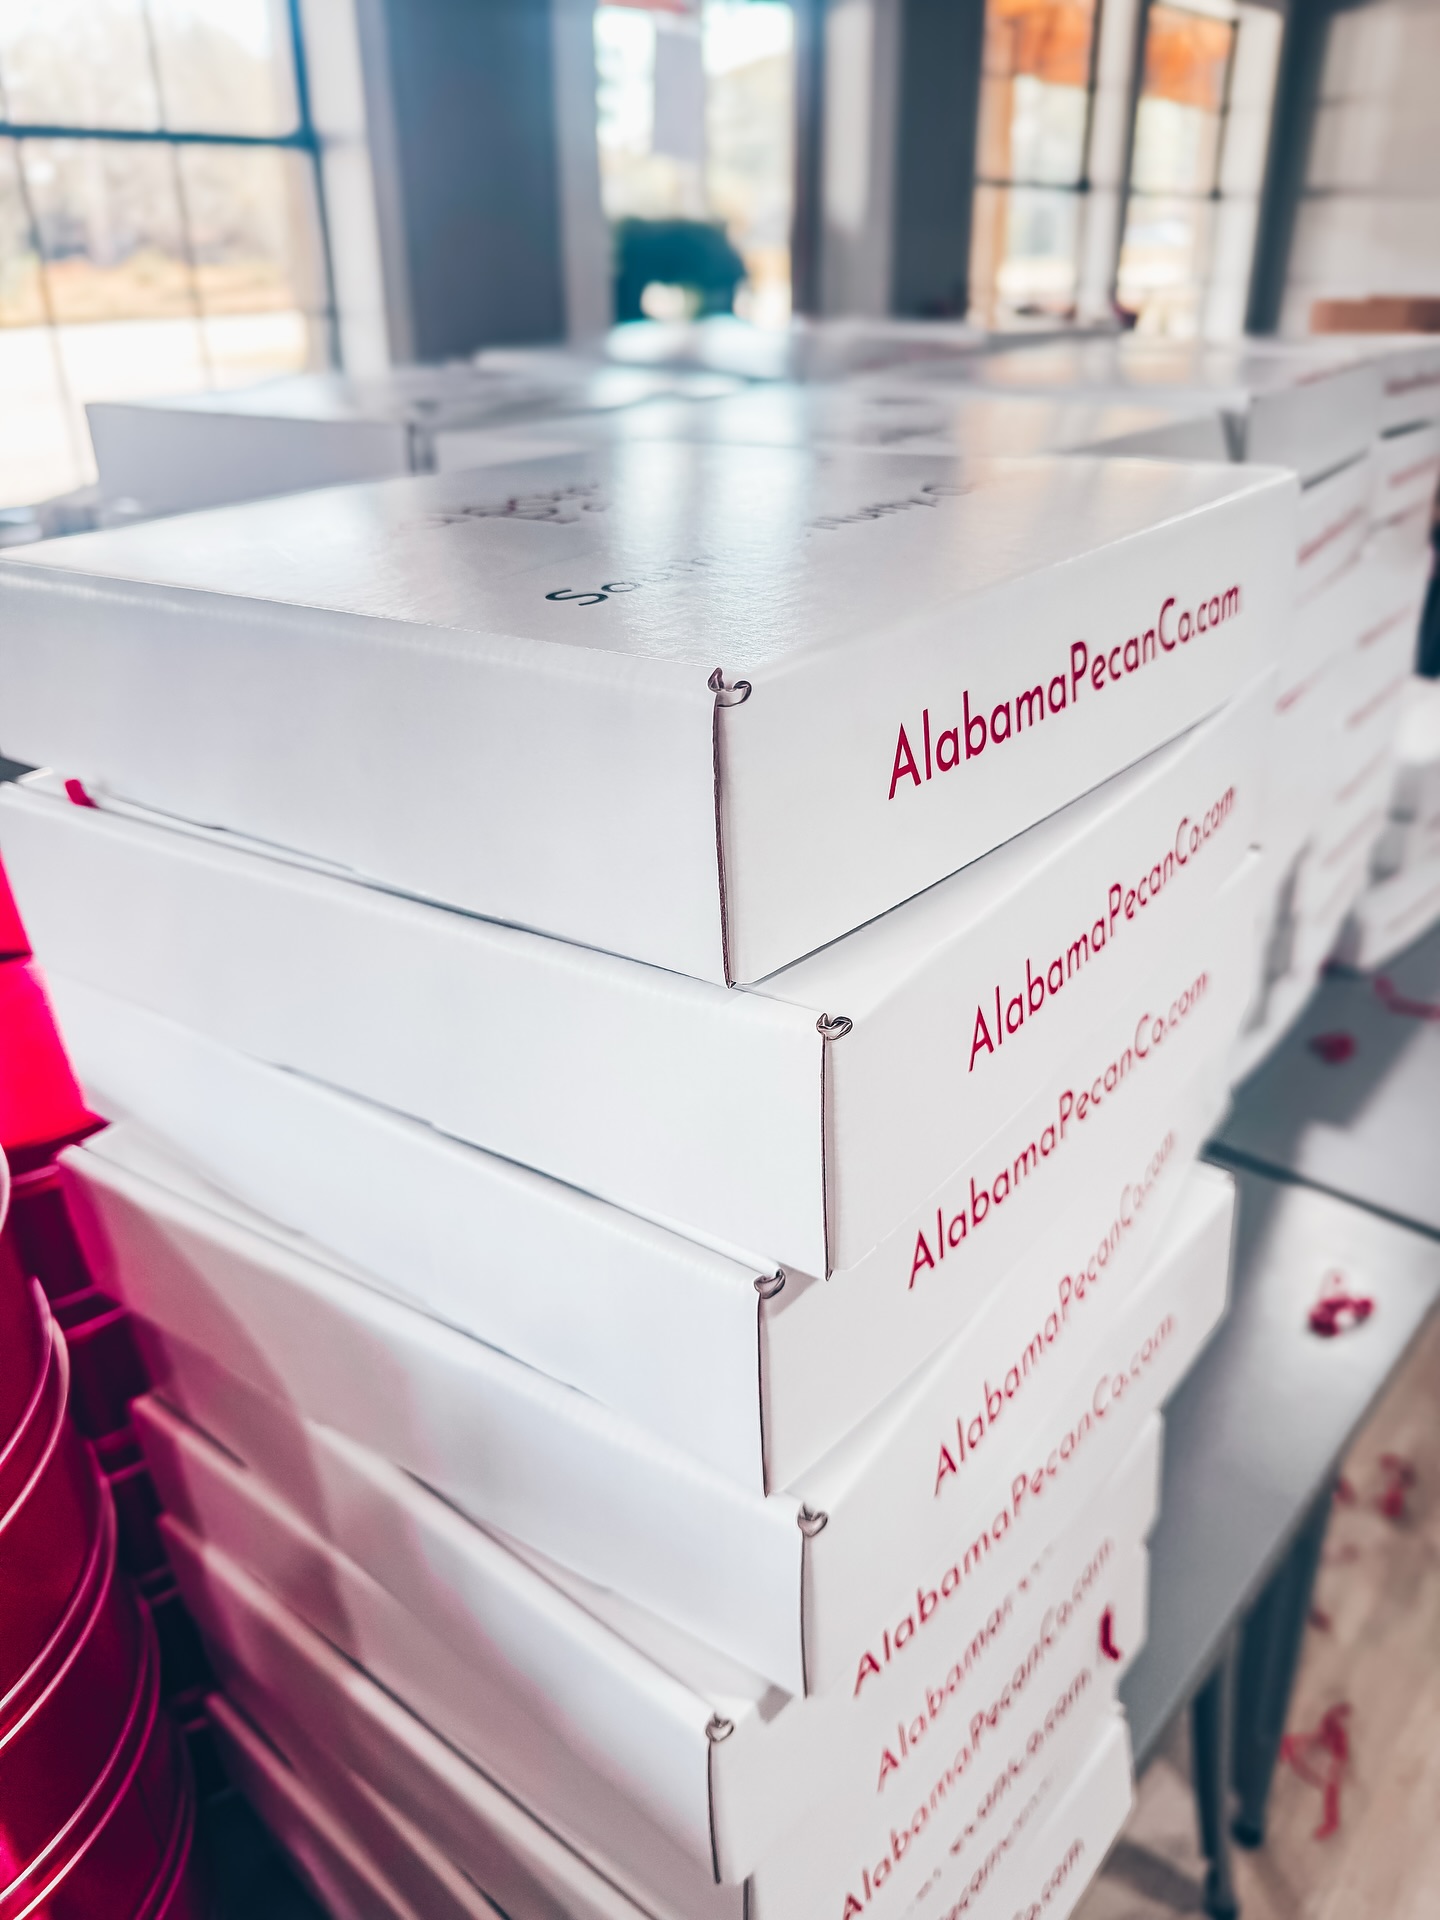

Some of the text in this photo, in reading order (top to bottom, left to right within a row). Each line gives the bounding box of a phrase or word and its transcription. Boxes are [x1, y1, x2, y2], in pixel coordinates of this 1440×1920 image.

[888, 583, 1242, 801] AlabamaPecanCo.com
[968, 785, 1237, 1073] AlabamaPecanCo.com
[908, 971, 1210, 1291] AlabamaPecanCo.com
[933, 1129, 1177, 1497] AlabamaPecanCo.com
[853, 1312, 1176, 1698] AlabamaPecanCo.com
